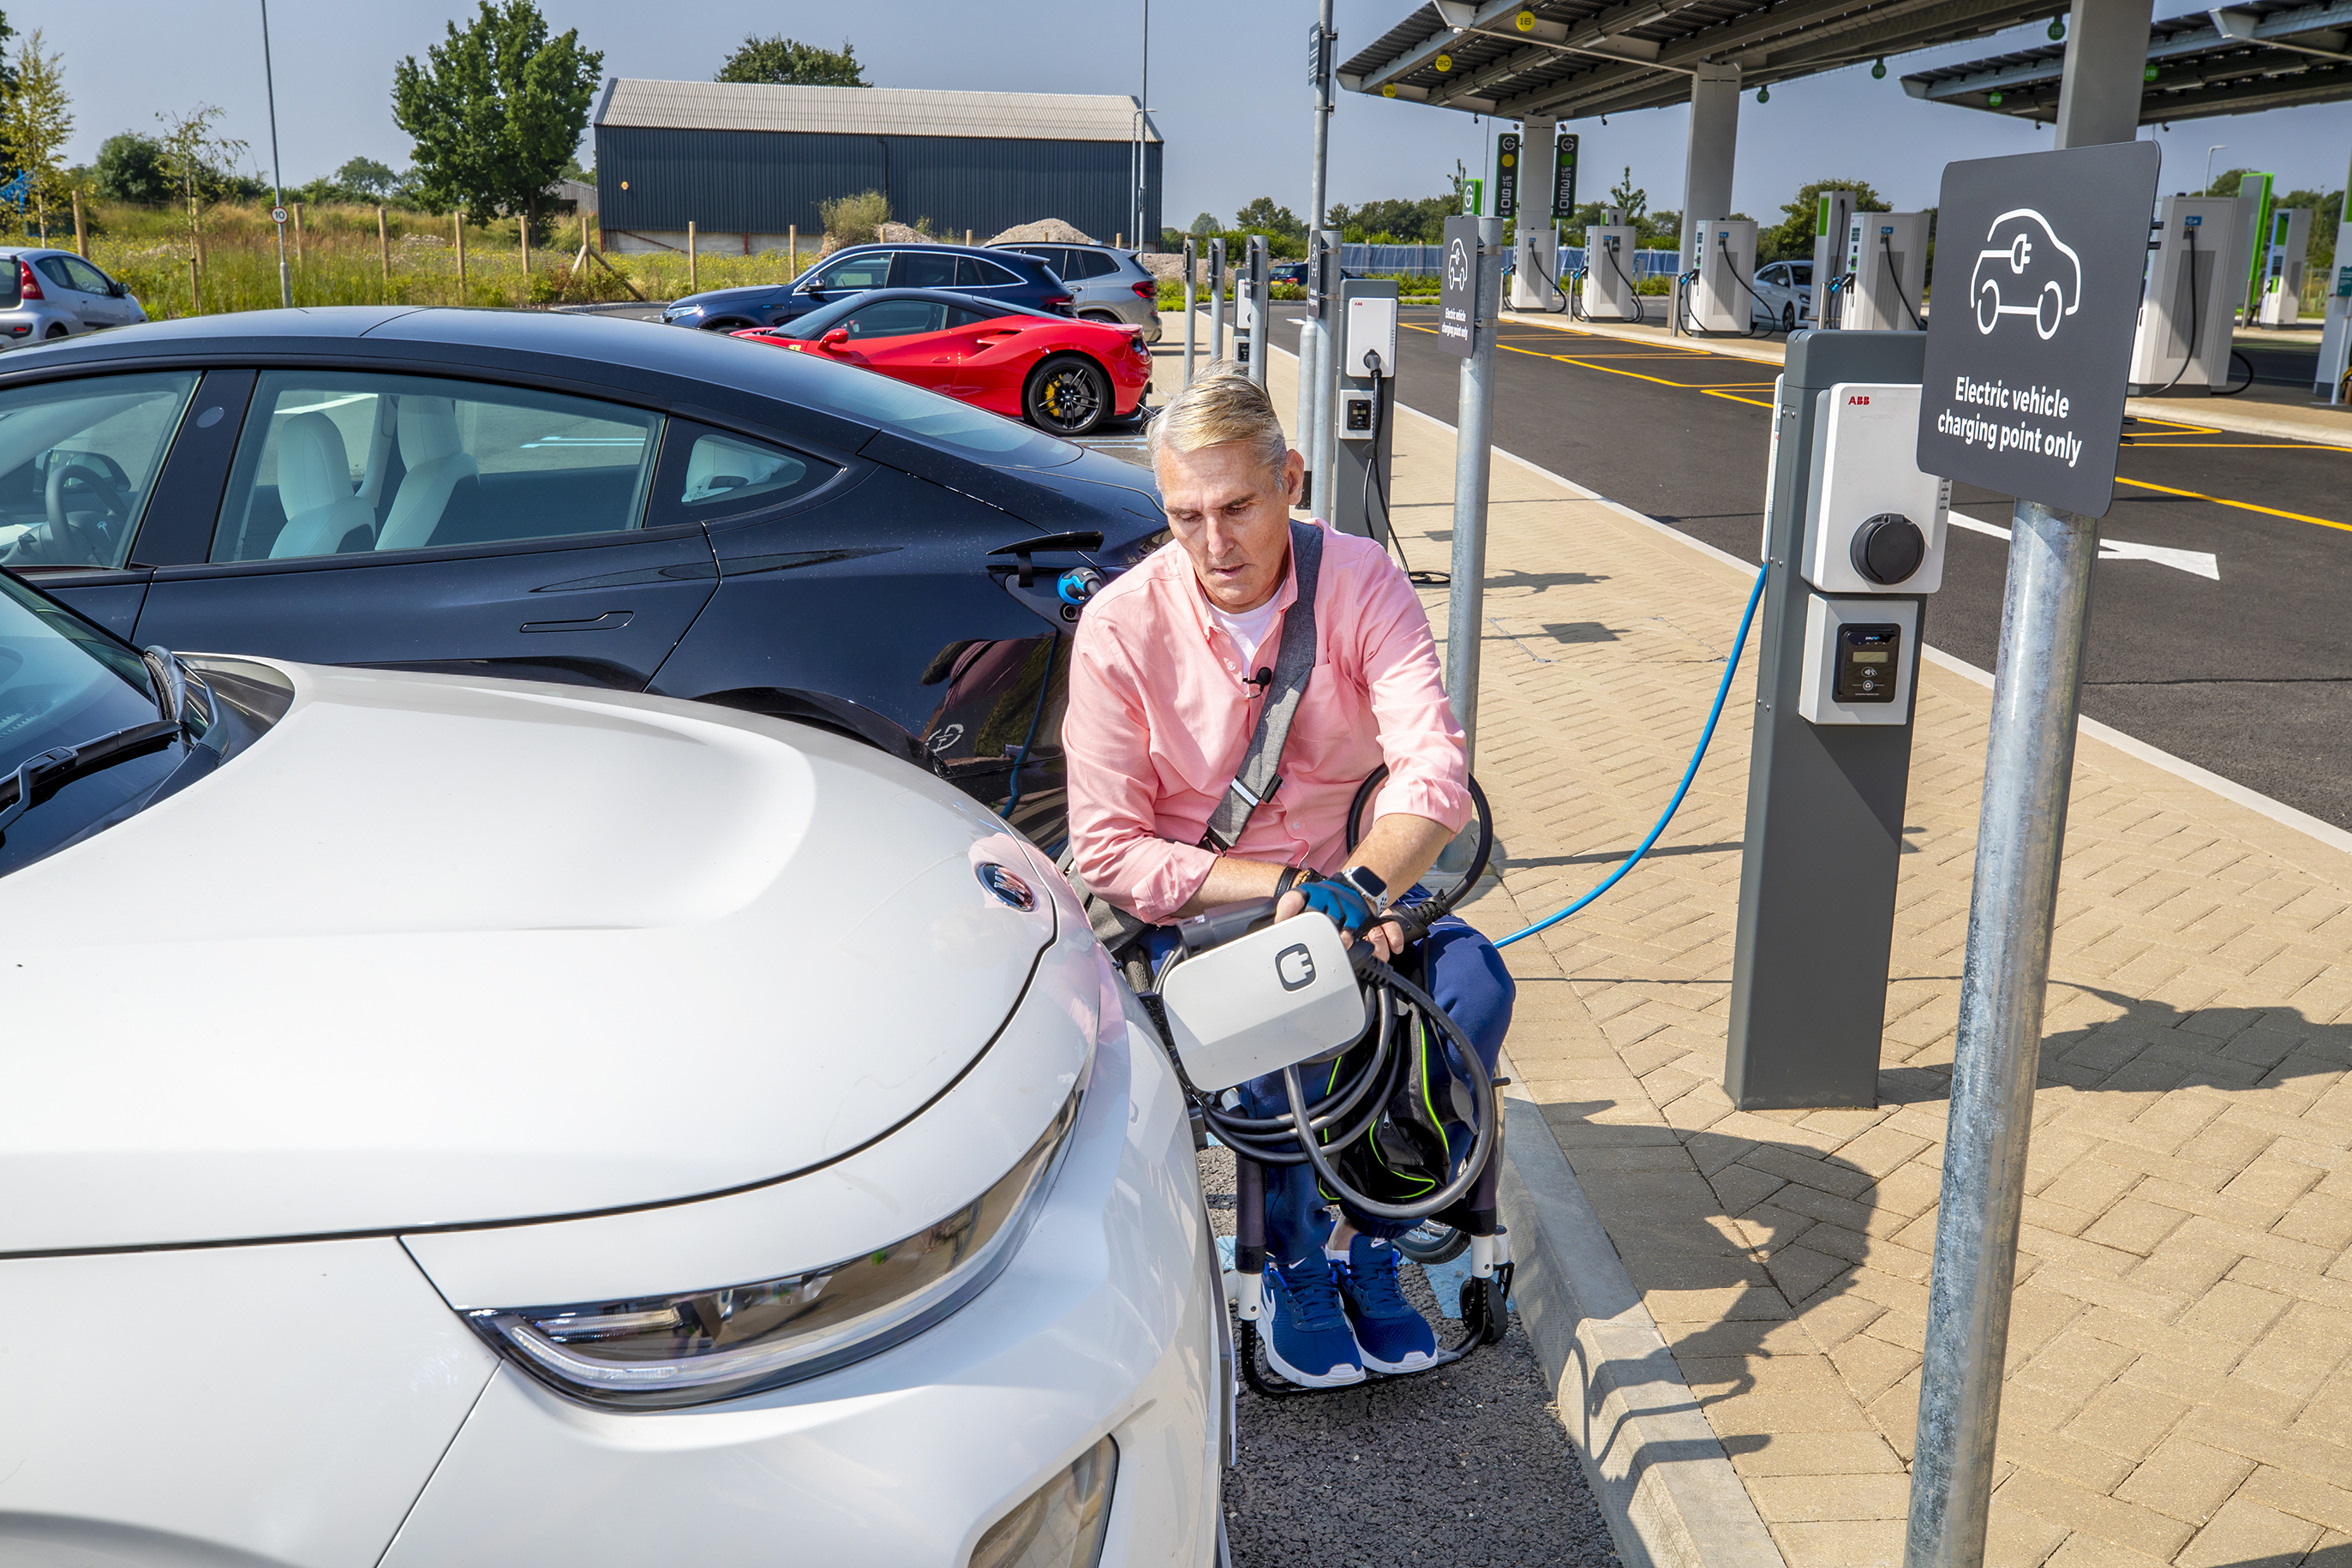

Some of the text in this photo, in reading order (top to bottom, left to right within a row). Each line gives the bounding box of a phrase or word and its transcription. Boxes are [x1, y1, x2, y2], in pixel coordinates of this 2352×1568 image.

[1519, 17, 1532, 26] 16
[2050, 27, 2063, 35] 15
[1501, 189, 1511, 209] 90
[1559, 179, 1571, 209] 350
[274, 211, 285, 219] 10
[1848, 396, 1870, 405] ABB
[1954, 375, 2070, 419] Electric vehicle
[1937, 408, 2083, 468] charging point only
